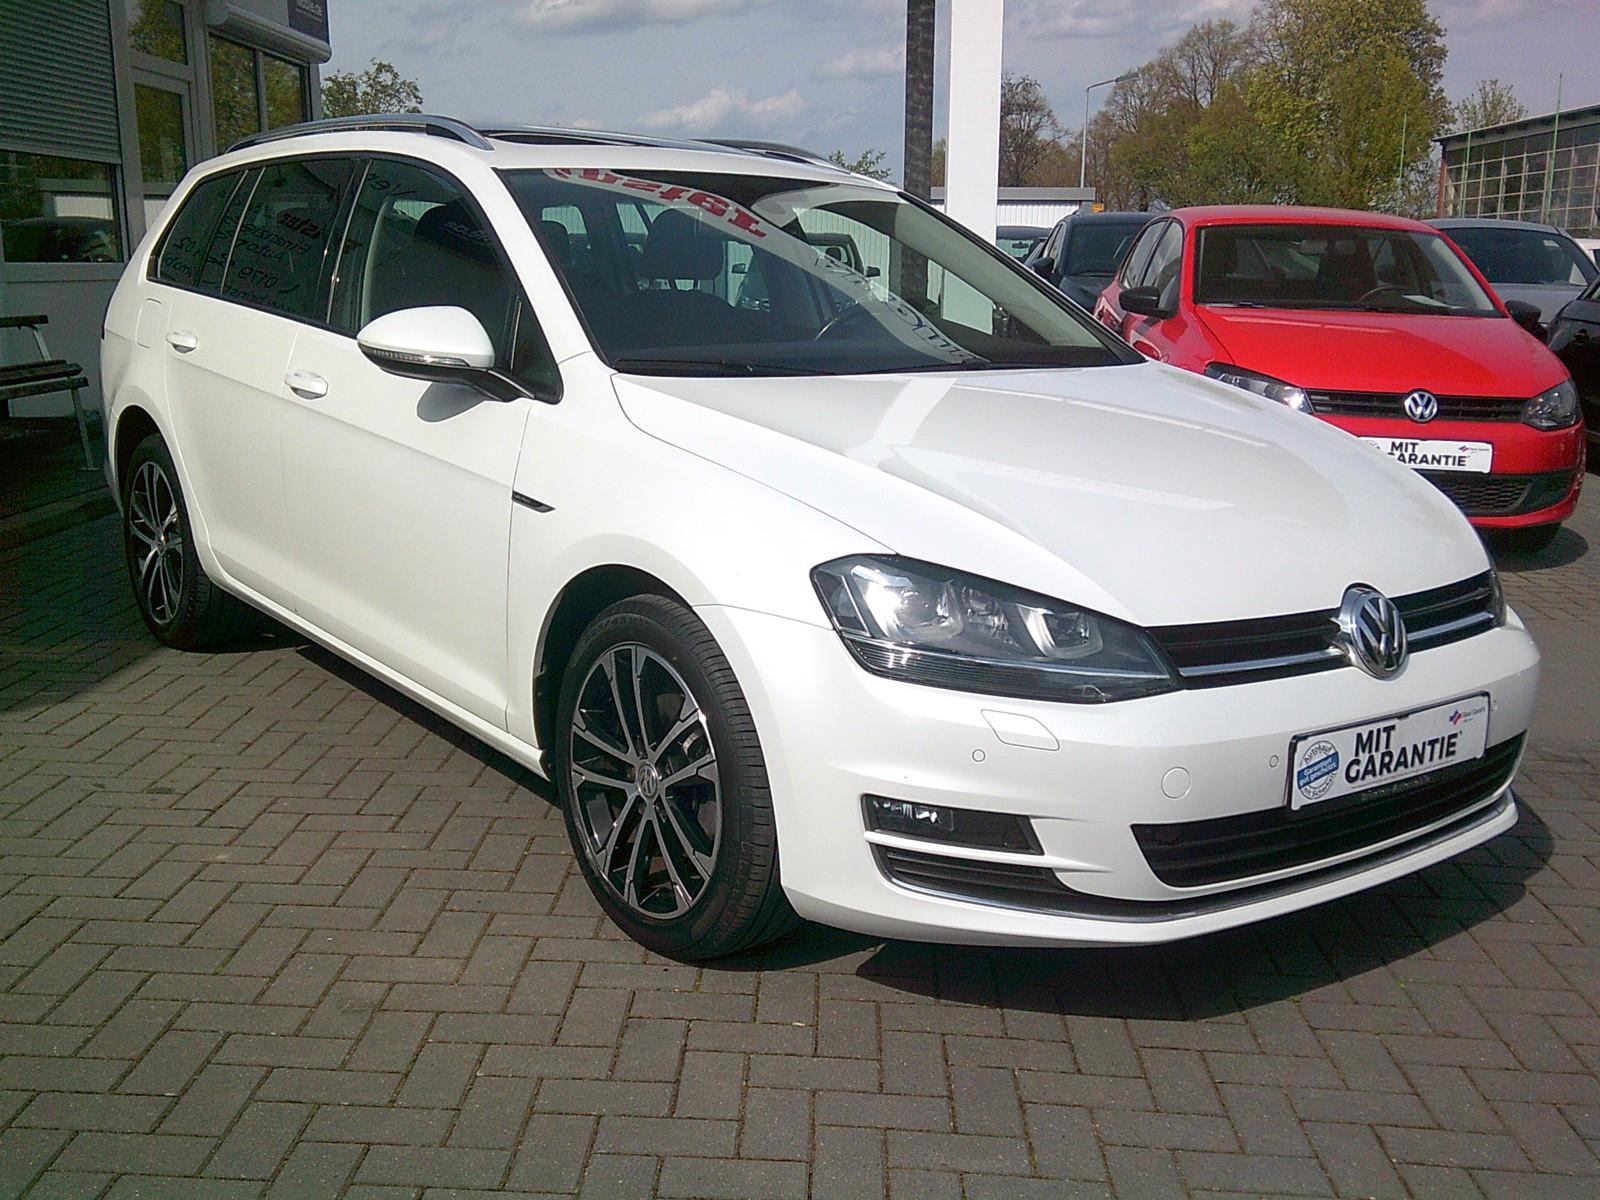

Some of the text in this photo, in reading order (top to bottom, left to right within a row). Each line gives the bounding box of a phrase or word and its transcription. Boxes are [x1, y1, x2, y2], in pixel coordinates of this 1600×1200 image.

[1390, 441, 1419, 454] MIT
[1388, 452, 1467, 467] ARANTIE
[1354, 724, 1396, 758] MIT
